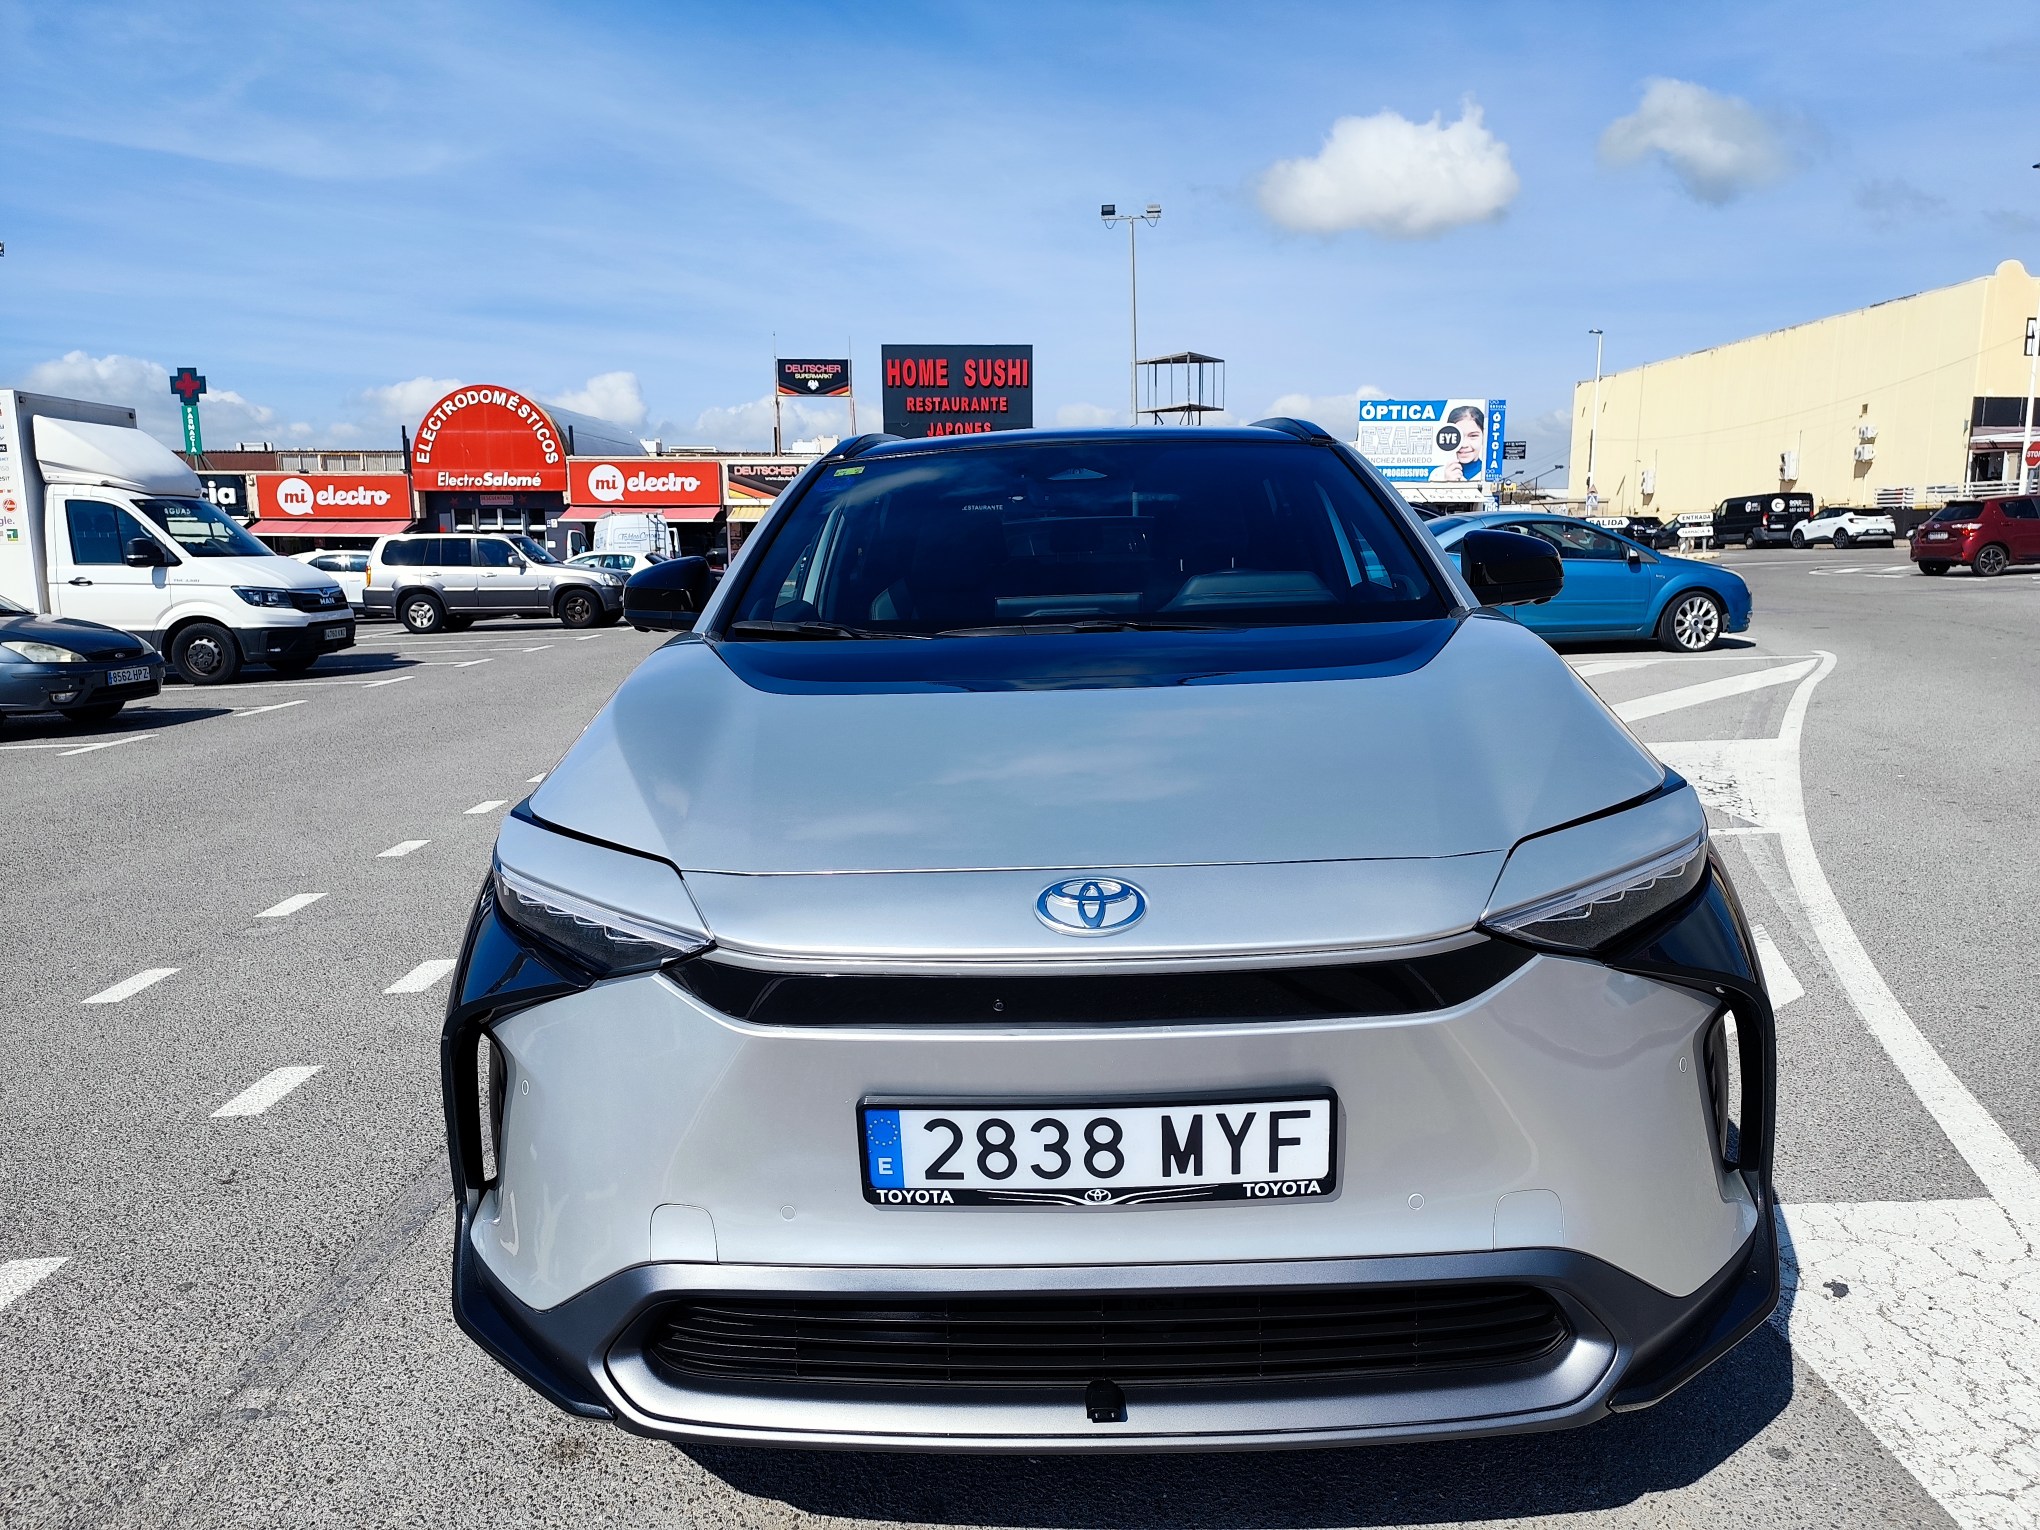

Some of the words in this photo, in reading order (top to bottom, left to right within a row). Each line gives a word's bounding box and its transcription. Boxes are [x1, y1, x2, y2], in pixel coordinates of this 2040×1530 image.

[785, 364, 841, 373] DEUTSCHER
[886, 359, 949, 387] HOME
[964, 358, 1028, 387] SUSHI
[906, 397, 1008, 412] RESTAURANTE
[1361, 401, 1436, 420] ÓPTICA
[186, 407, 198, 453] FARMACIA
[416, 389, 559, 464] ELECTRODOMÉSTICOS
[927, 422, 991, 437] JAPONES
[1438, 433, 1458, 445] EYE
[1368, 456, 1396, 464] NCHEZ
[1396, 456, 1433, 464] BARREDO
[437, 472, 542, 486] ElectroSalomé
[734, 466, 798, 475] DEUTSCHER
[595, 475, 619, 490] mi
[626, 471, 701, 492] electro
[284, 489, 307, 504] mi
[316, 485, 391, 506] electro
[113, 670, 133, 683] 8562
[132, 668, 149, 681] HPZ
[924, 1117, 1125, 1180] 2838
[1161, 1109, 1311, 1178] MYF
[878, 1157, 894, 1175] E
[876, 1189, 954, 1204] TOYOTA
[1242, 1180, 1322, 1197] TOYOTA
